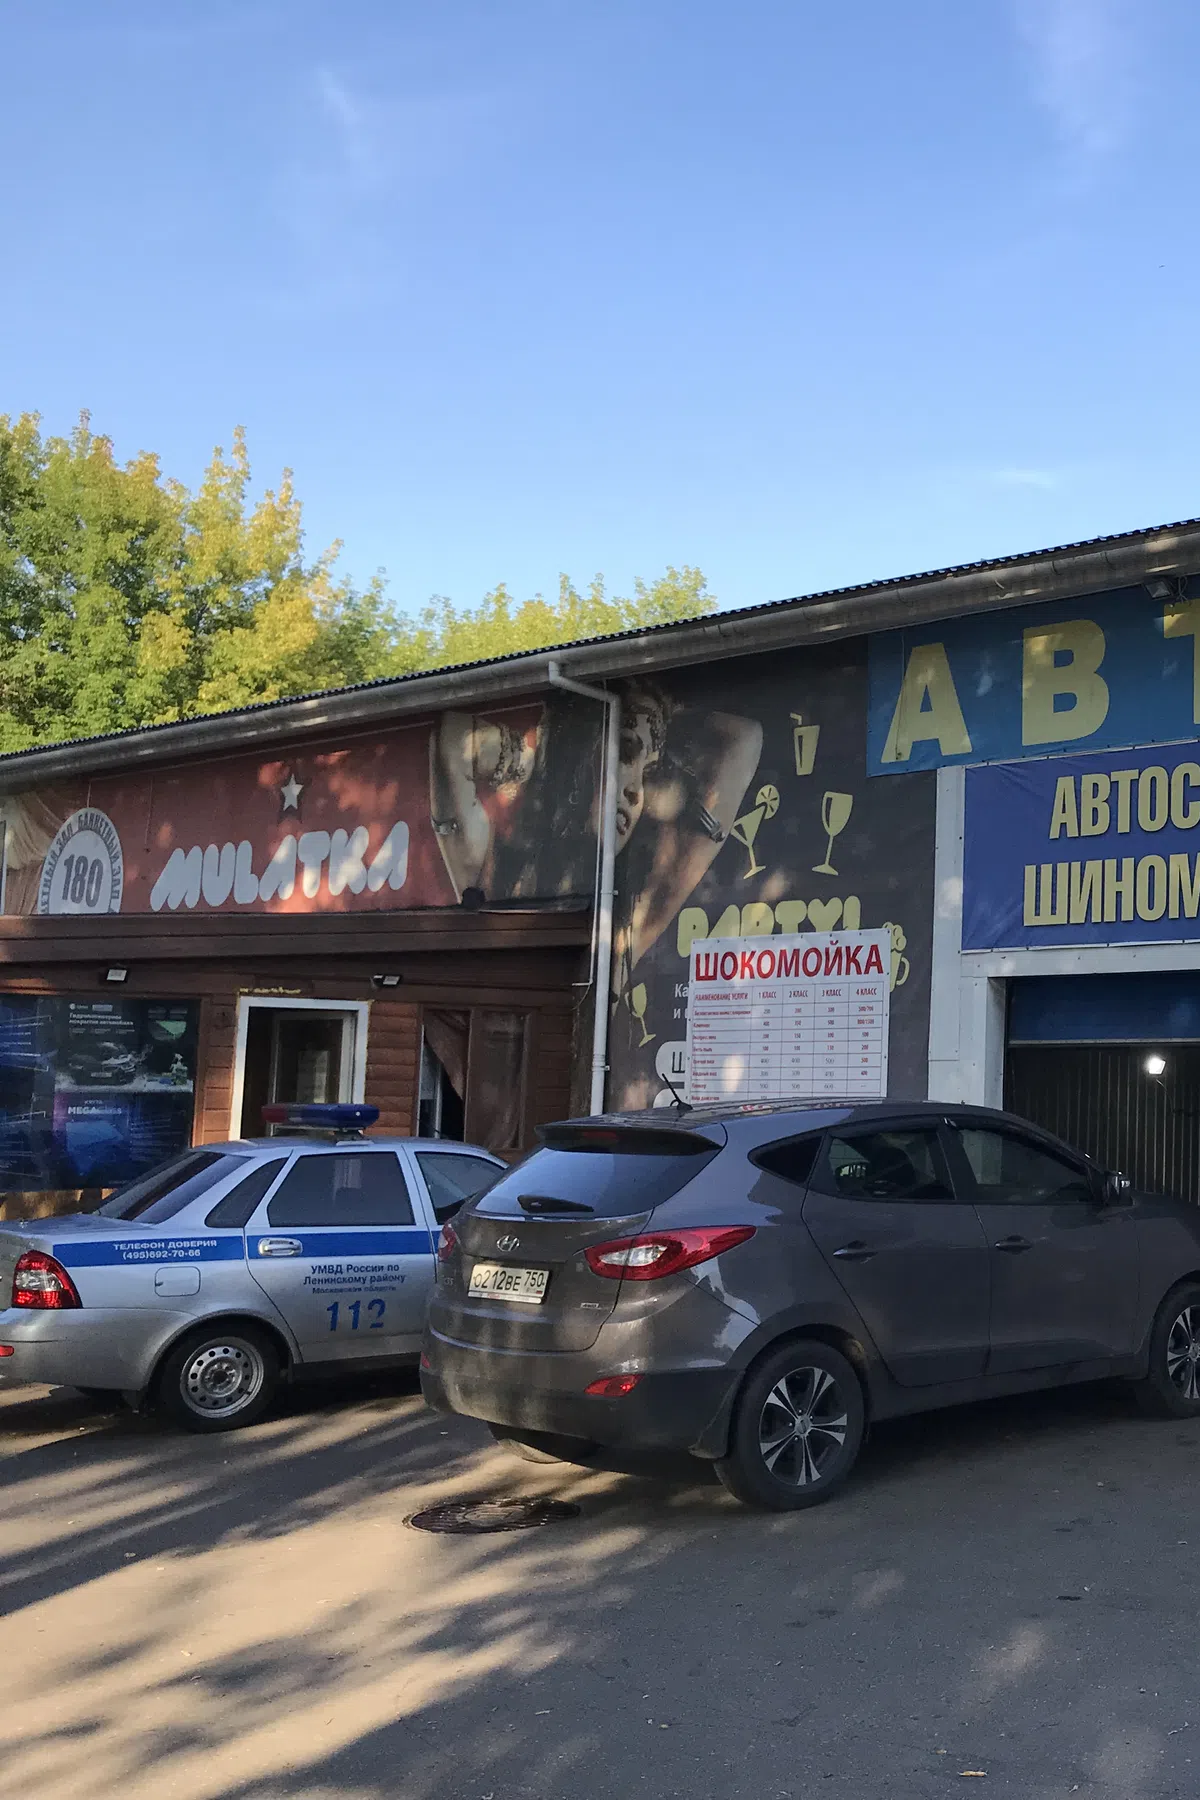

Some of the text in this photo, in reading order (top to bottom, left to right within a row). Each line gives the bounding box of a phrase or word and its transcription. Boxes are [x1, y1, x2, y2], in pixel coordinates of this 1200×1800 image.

[150, 820, 409, 912] MULATKA
[62, 853, 104, 908] 180
[695, 940, 883, 981] ШОКОМОЙКА
[794, 990, 808, 998] КЛАСС
[860, 988, 877, 996] КЛАСС
[113, 1240, 217, 1250] ТЕЛЕФОН ДОВЕРИЯ
[311, 1264, 344, 1275] УМВД
[346, 1264, 384, 1273] России
[303, 1274, 406, 1285] Ленинскому району
[524, 1271, 544, 1288] 750
[326, 1298, 386, 1332] 112
